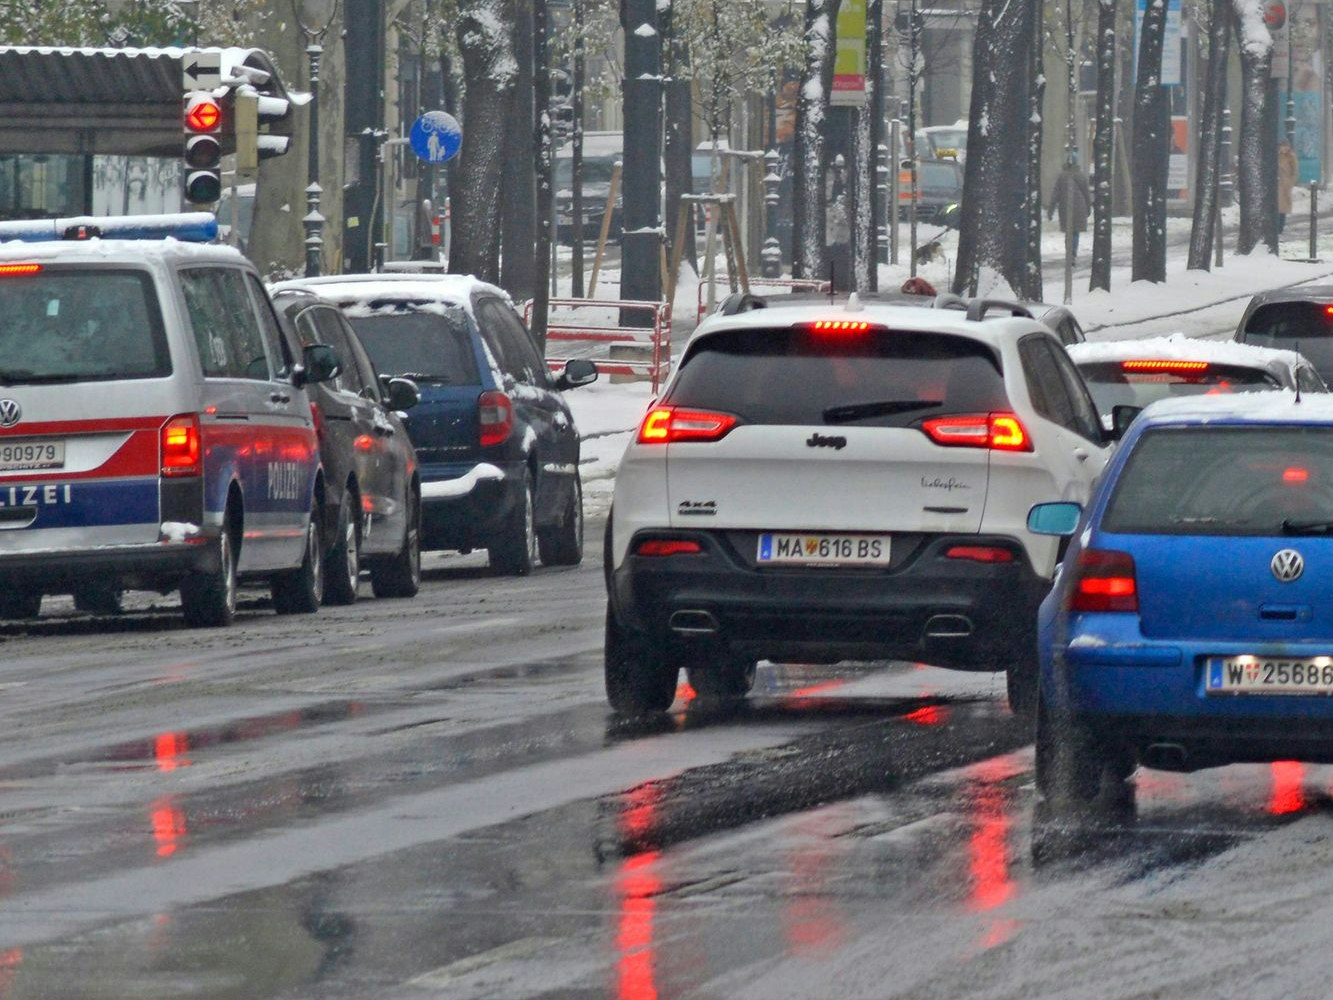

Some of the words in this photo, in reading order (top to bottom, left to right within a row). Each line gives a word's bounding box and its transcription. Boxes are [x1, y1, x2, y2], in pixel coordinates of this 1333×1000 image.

[806, 432, 847, 450] Jeep
[267, 461, 299, 500] POLIZEI
[0, 484, 71, 508] IZEI
[679, 500, 717, 508] 4x4
[777, 539, 803, 558] MA
[819, 539, 851, 558] 616
[858, 539, 881, 558] BS
[1228, 664, 1244, 684] W
[1264, 663, 1333, 685] 25686
